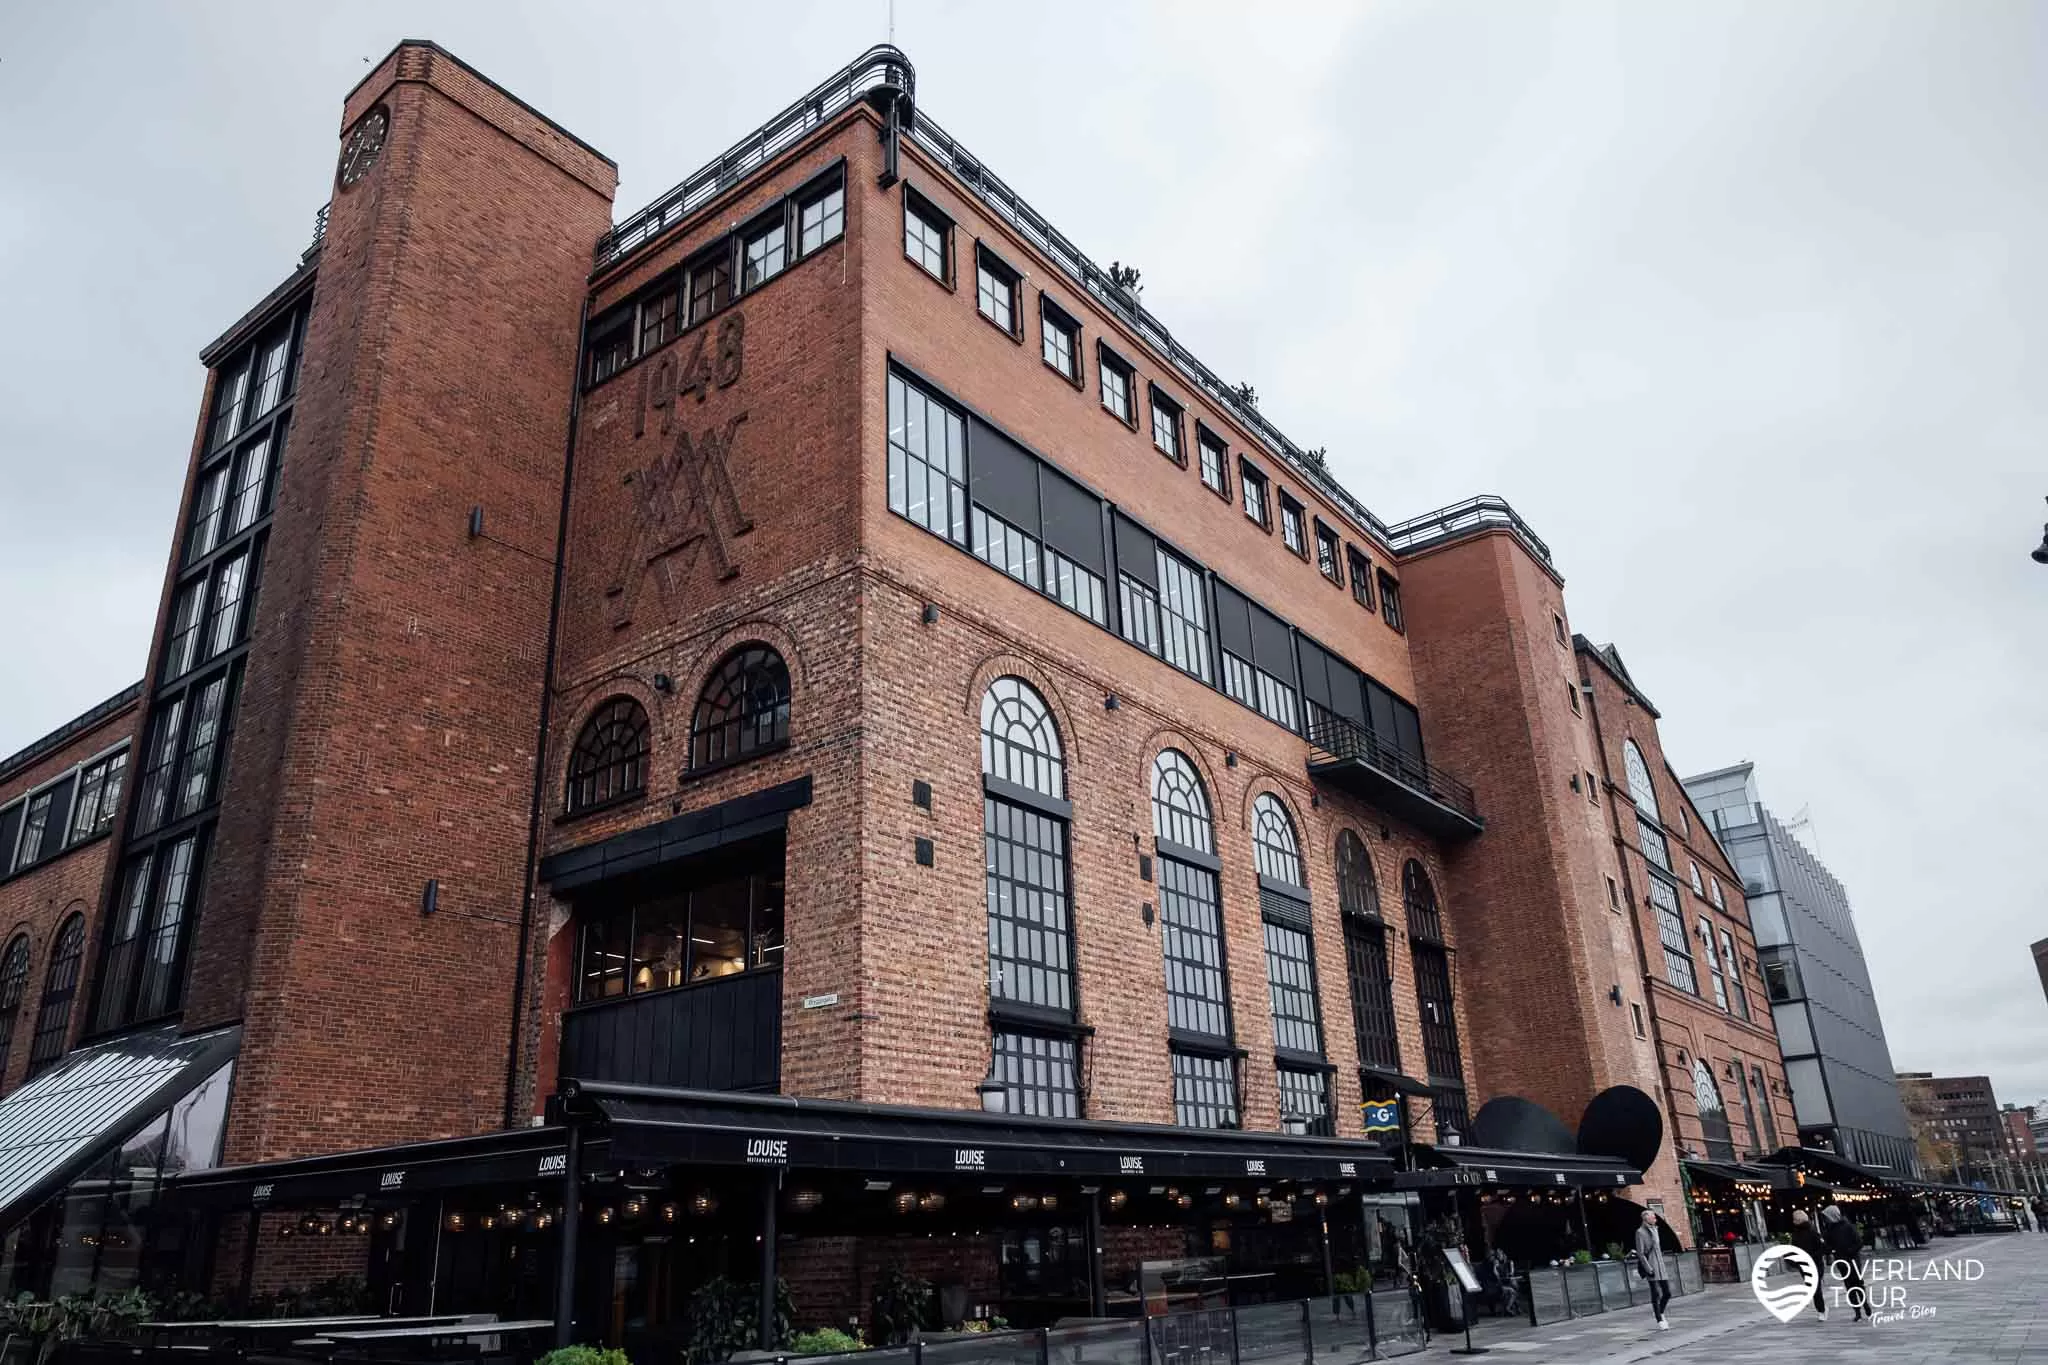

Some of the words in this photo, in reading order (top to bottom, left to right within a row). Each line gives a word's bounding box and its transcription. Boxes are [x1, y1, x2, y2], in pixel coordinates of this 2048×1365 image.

[633, 311, 745, 440] 1948
[747, 1139, 788, 1157] LOUISE
[955, 1149, 985, 1164] LOUISE
[1120, 1156, 1144, 1169] LOUISE
[1246, 1160, 1266, 1171] LOUISE
[381, 1171, 406, 1186] LOUISE
